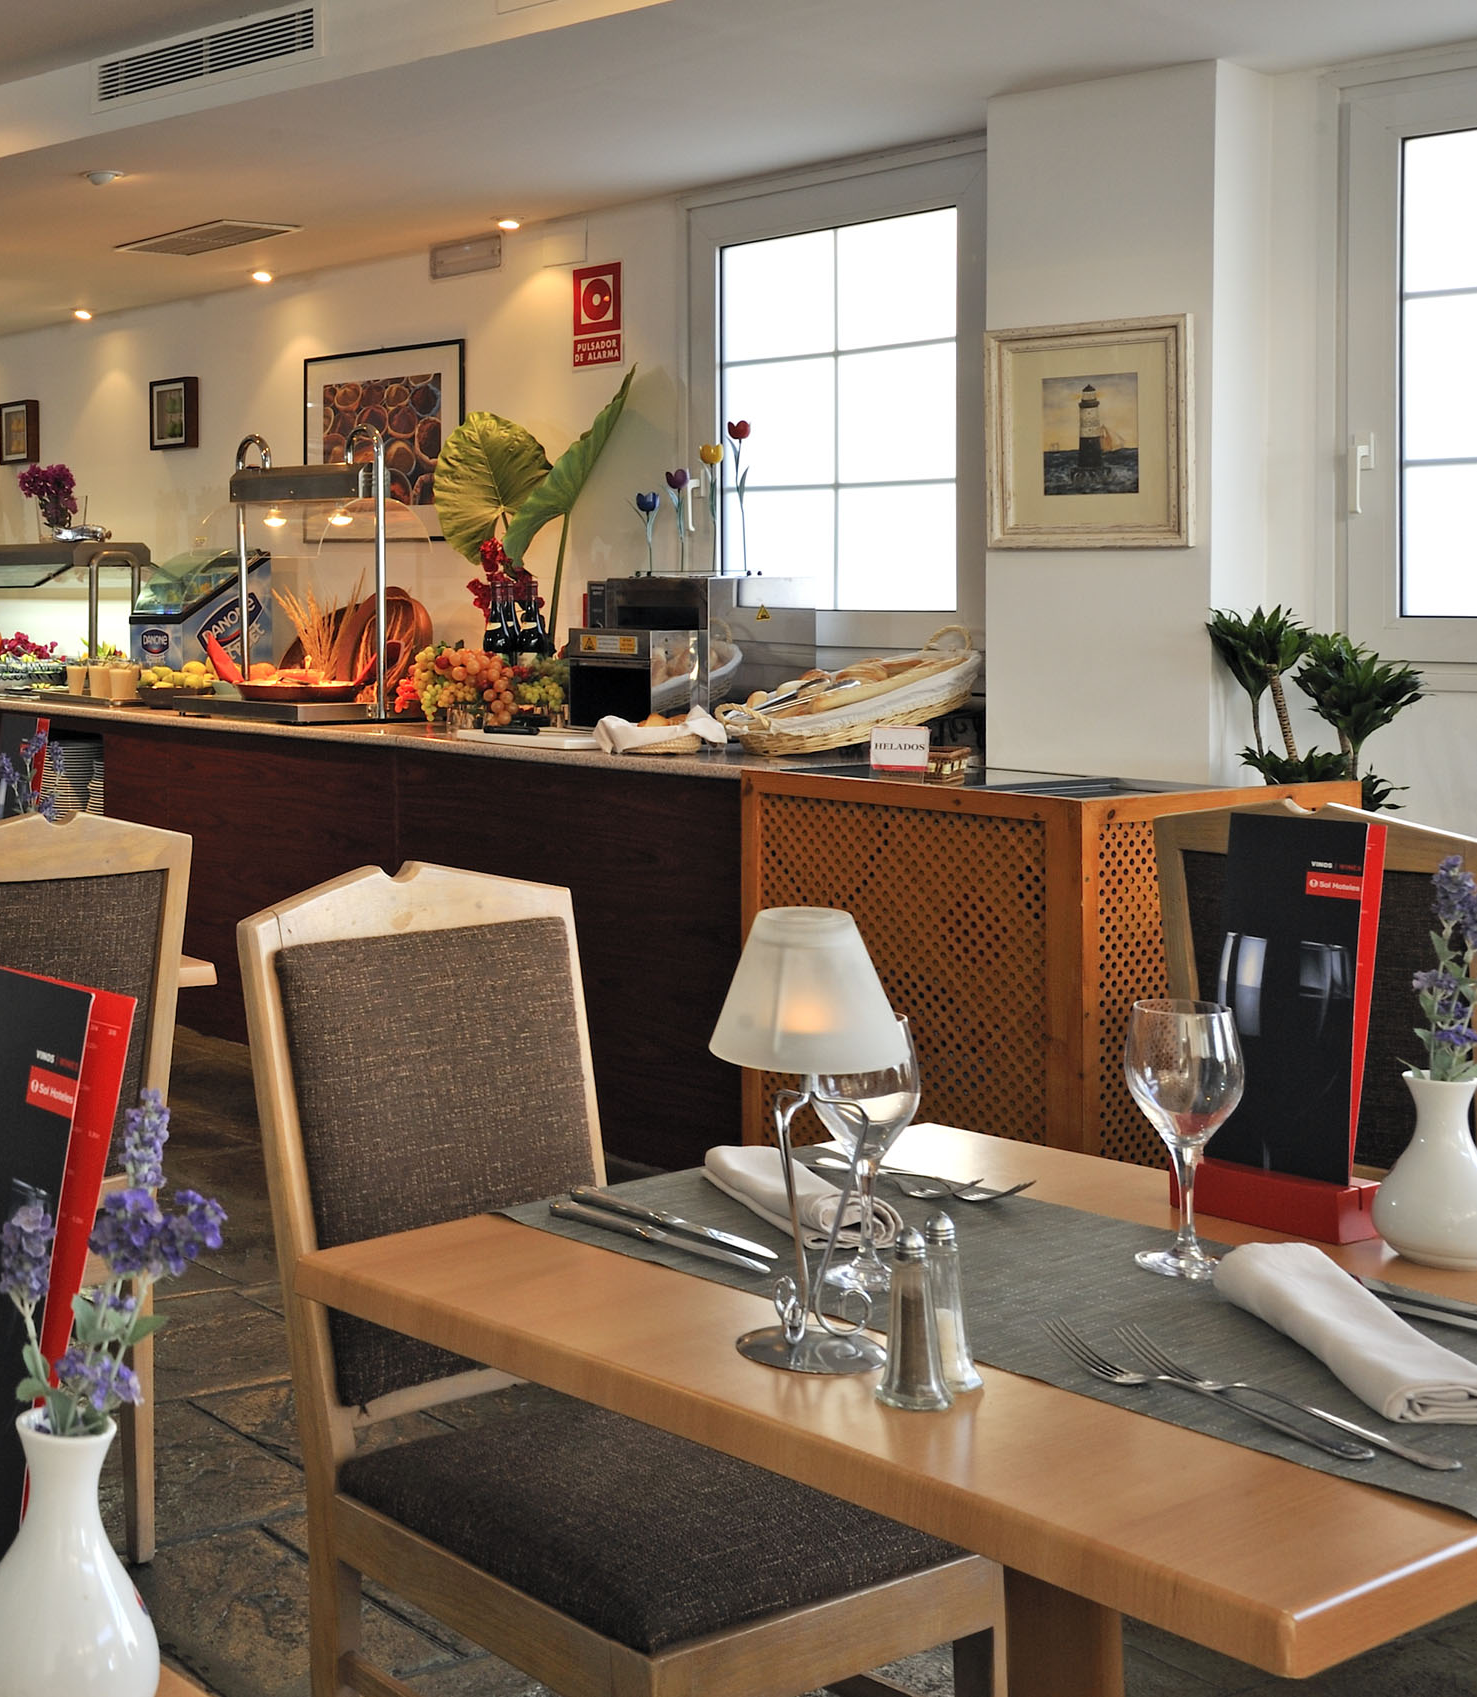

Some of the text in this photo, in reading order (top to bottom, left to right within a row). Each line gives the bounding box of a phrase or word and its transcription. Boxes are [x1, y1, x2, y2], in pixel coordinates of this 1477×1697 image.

[577, 339, 617, 352] PULSADOR
[575, 349, 620, 362] DE ALARMA
[874, 742, 926, 751] HELADOS
[1311, 861, 1333, 869] VINOS
[36, 1049, 55, 1064] VINOS
[38, 1083, 74, 1104] Sol Hoteles
